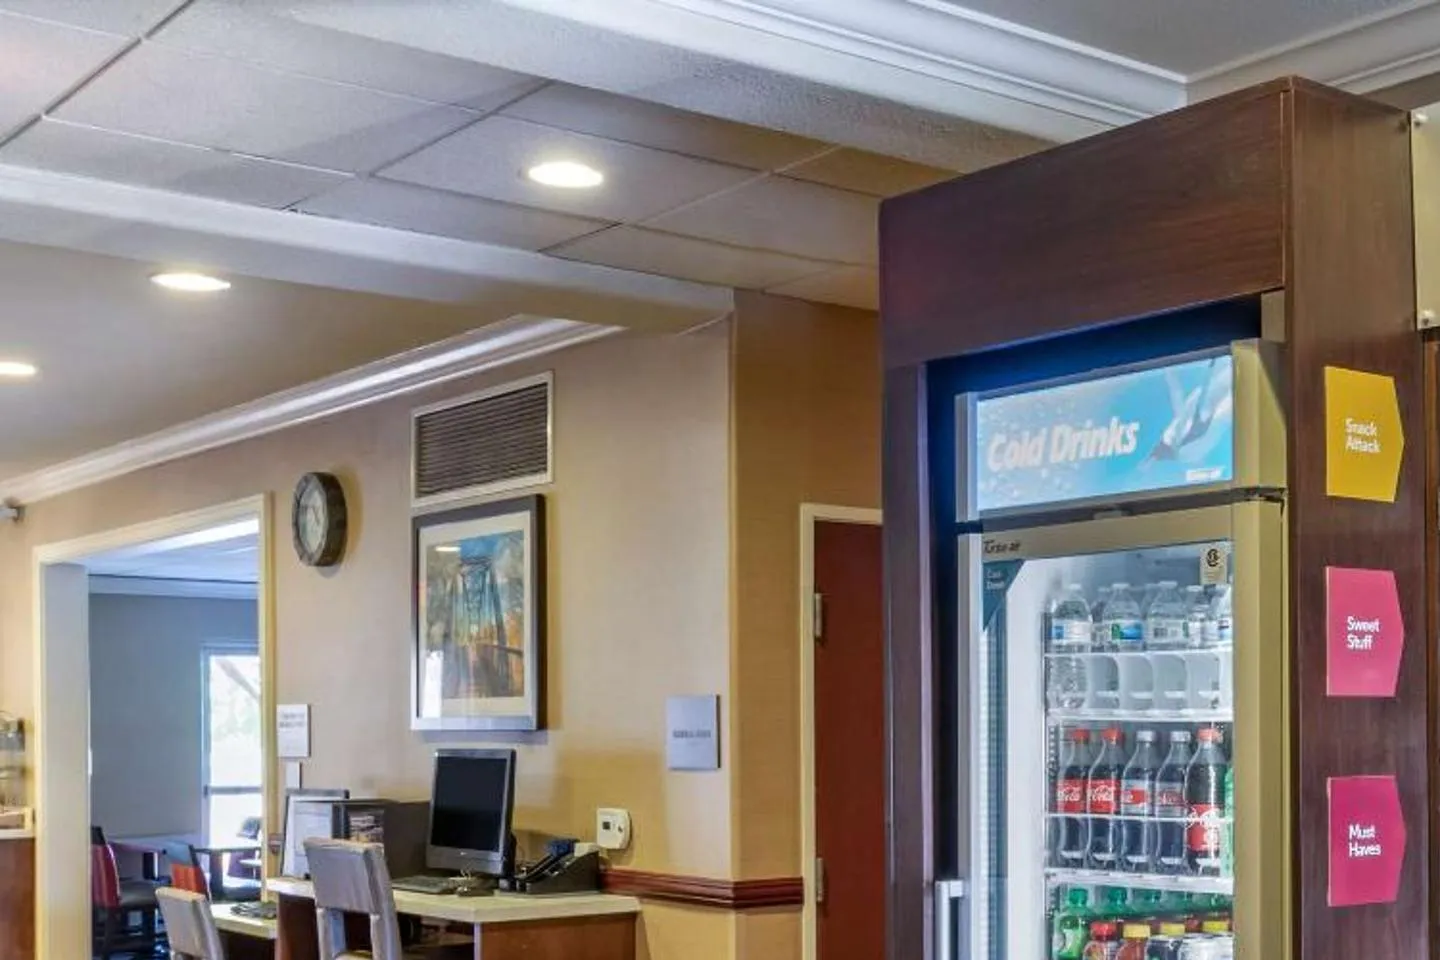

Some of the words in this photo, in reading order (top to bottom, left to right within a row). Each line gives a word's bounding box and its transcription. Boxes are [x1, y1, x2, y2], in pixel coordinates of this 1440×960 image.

[1345, 417, 1377, 437] Snack
[987, 428, 1046, 472] Cold
[1050, 416, 1140, 464] Drinks
[1347, 615, 1380, 633] Sweet
[1347, 634, 1373, 650] Stuff
[1348, 823, 1376, 840] Must
[1348, 841, 1382, 857] Haves
